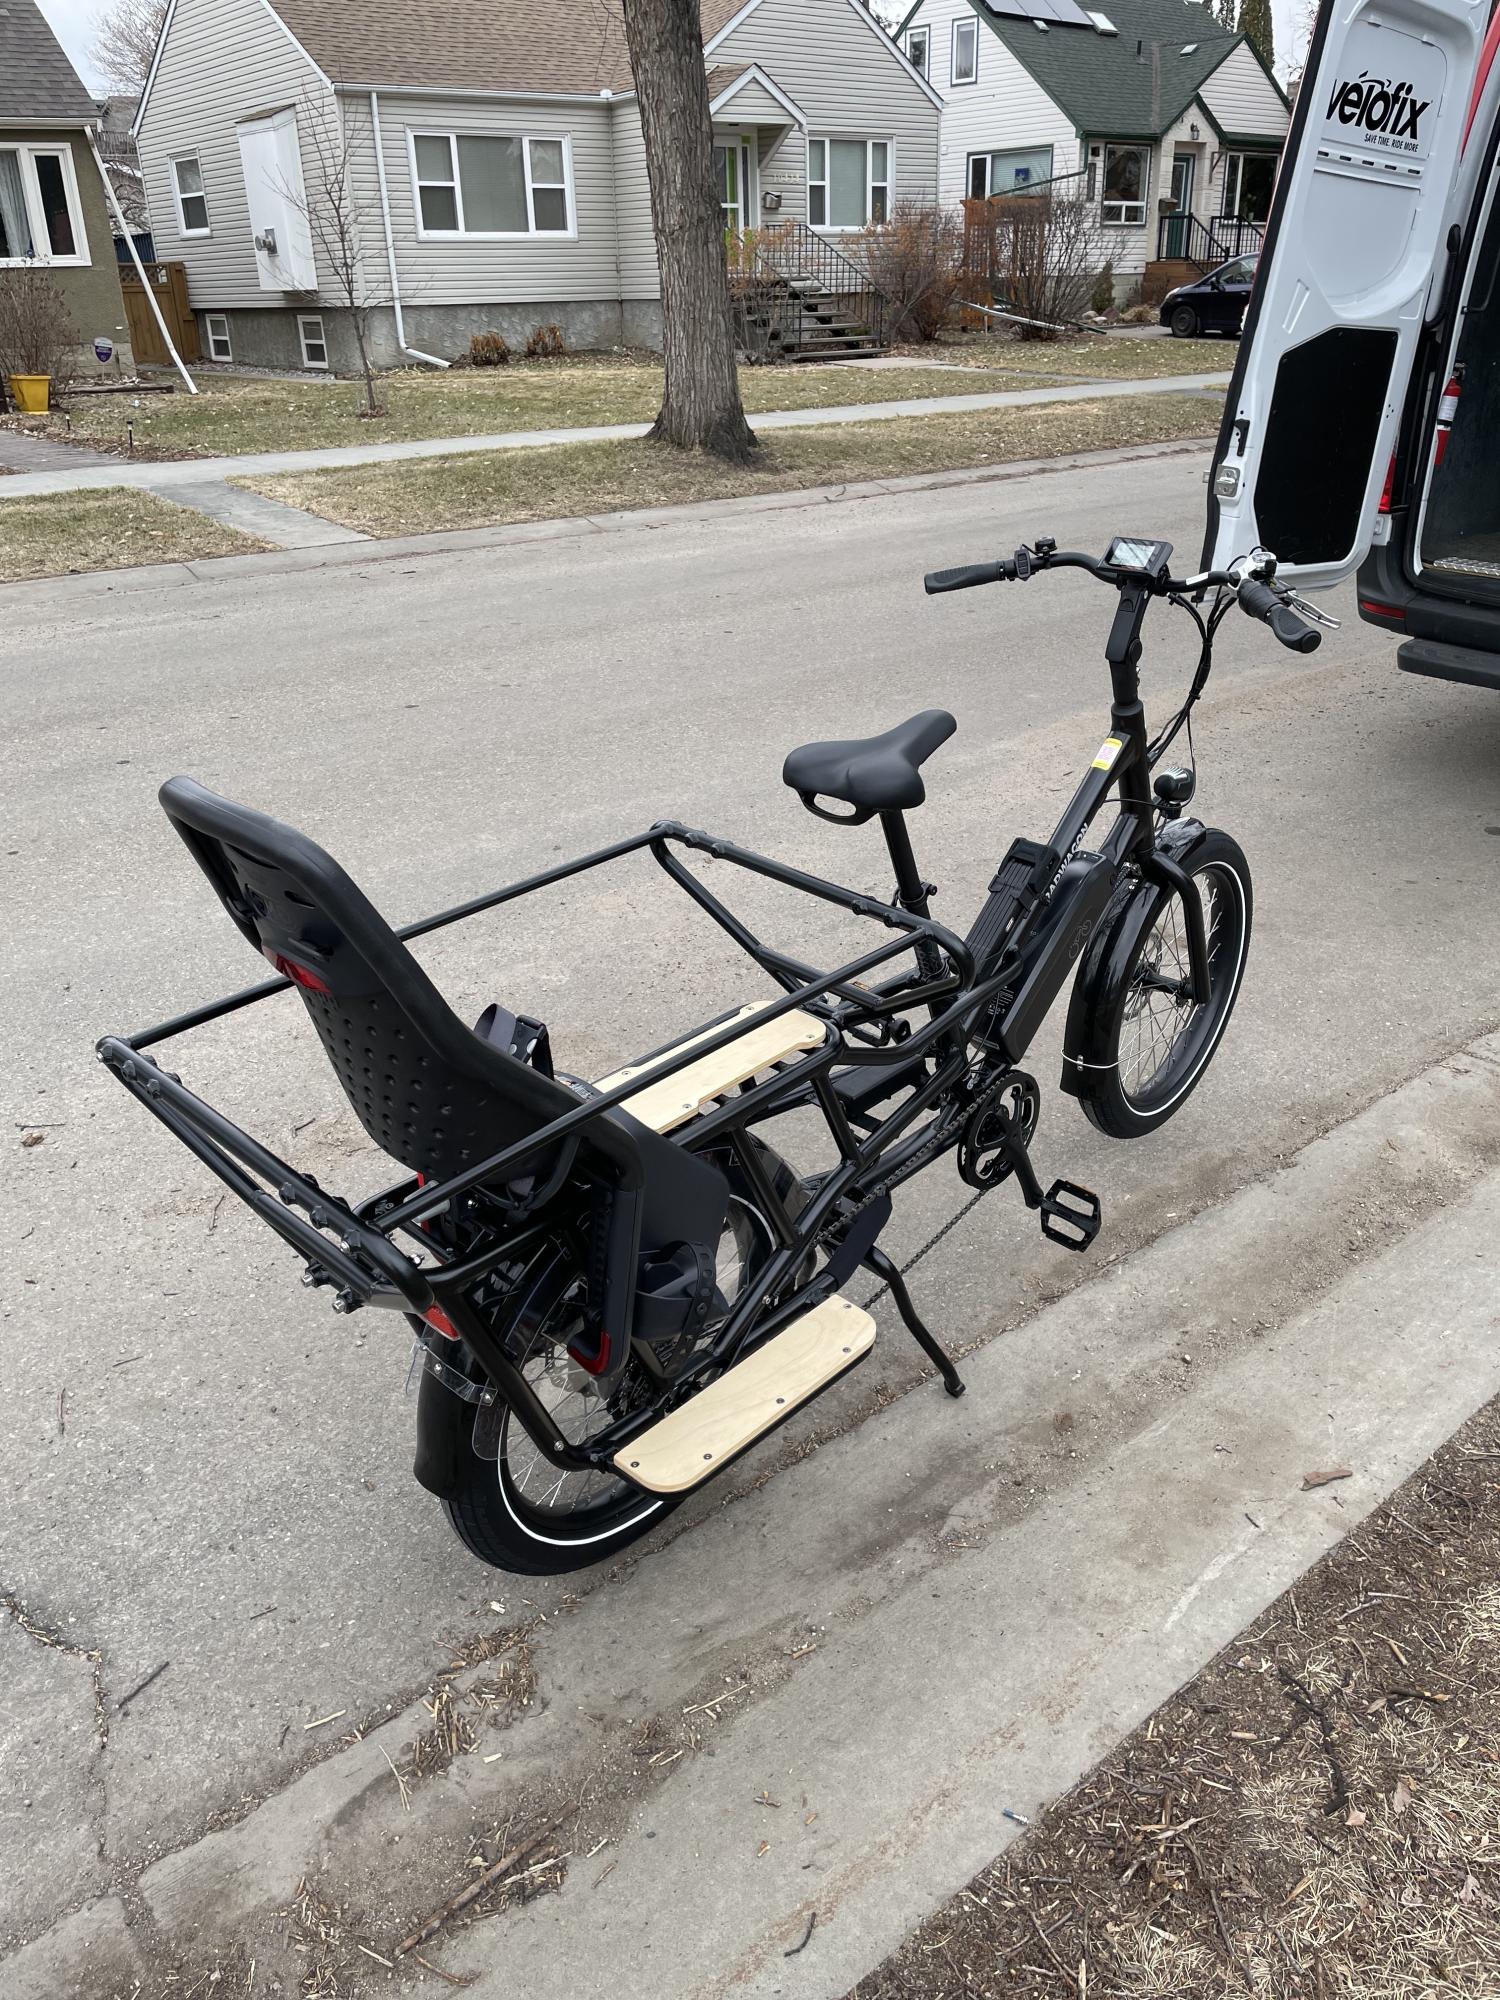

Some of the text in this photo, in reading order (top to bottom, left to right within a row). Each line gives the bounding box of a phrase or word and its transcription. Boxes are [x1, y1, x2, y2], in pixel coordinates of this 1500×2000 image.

[1364, 133, 1378, 144] SAVE
[1391, 138, 1404, 150] RIDE
[1403, 141, 1419, 153] MORE
